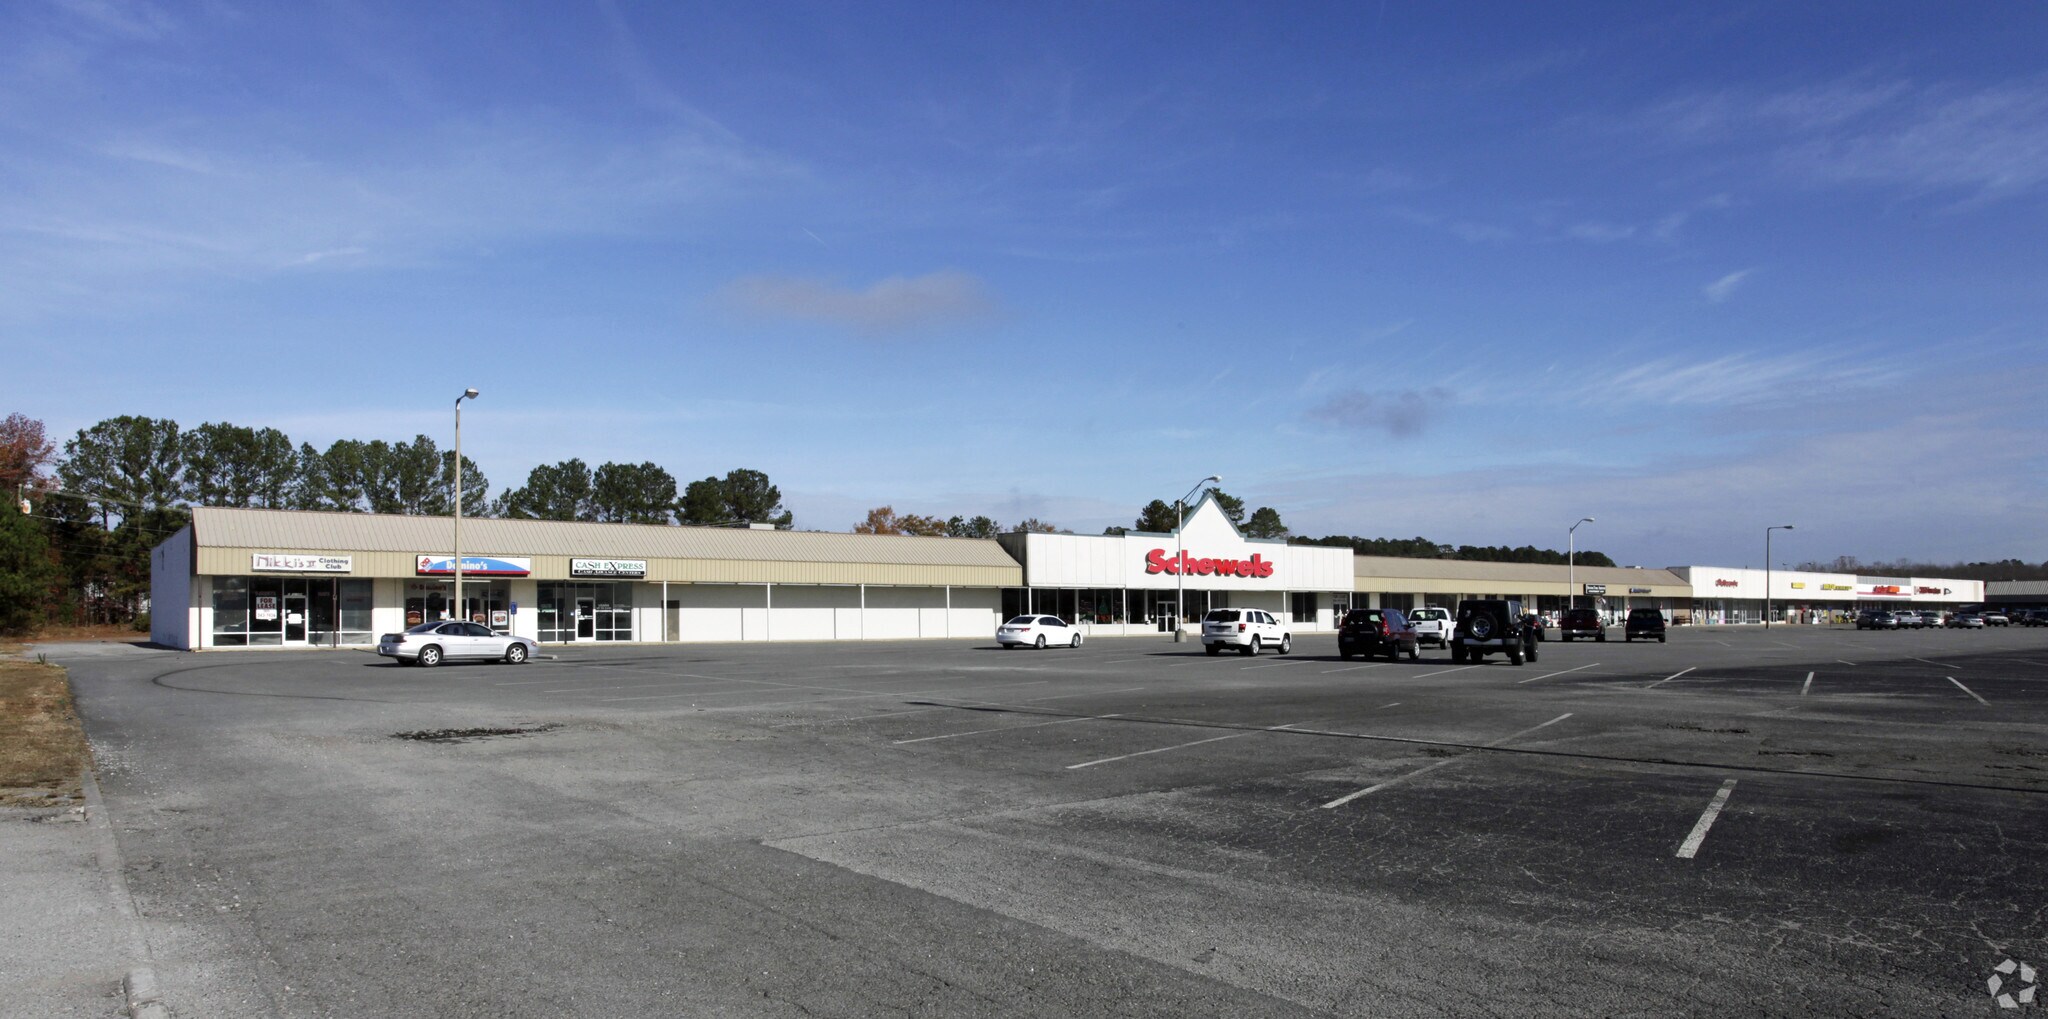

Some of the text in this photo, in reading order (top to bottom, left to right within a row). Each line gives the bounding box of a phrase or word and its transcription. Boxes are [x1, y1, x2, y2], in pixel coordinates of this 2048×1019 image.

[575, 561, 643, 570] CASH EXPRESS
[1146, 549, 1273, 577] Schewels
